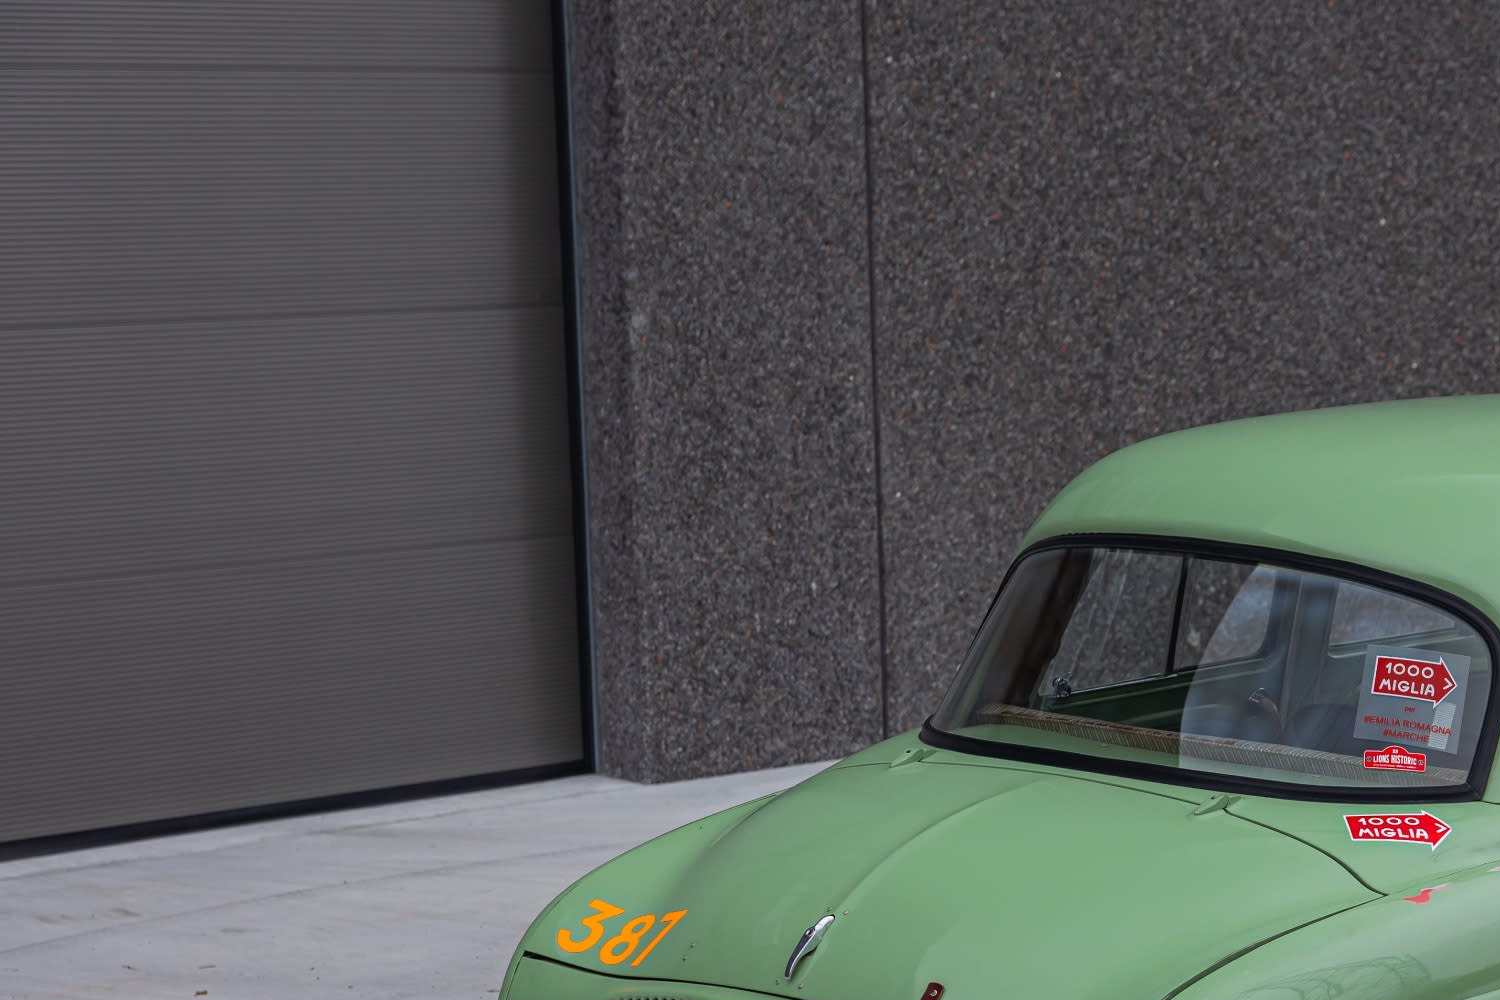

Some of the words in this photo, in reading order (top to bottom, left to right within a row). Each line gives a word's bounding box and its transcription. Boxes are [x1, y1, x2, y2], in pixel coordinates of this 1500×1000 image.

[1385, 662, 1434, 679] 1000
[1379, 678, 1435, 697] MIGLIA
[1383, 727, 1430, 743] #MARCHE
[1403, 719, 1452, 736] ROMAGNA
[1373, 754, 1390, 763] LIONS
[1391, 755, 1417, 765] HISTORIC
[1358, 817, 1420, 825] 1000
[1359, 828, 1429, 839] MIGLIA
[557, 898, 689, 968] 387
